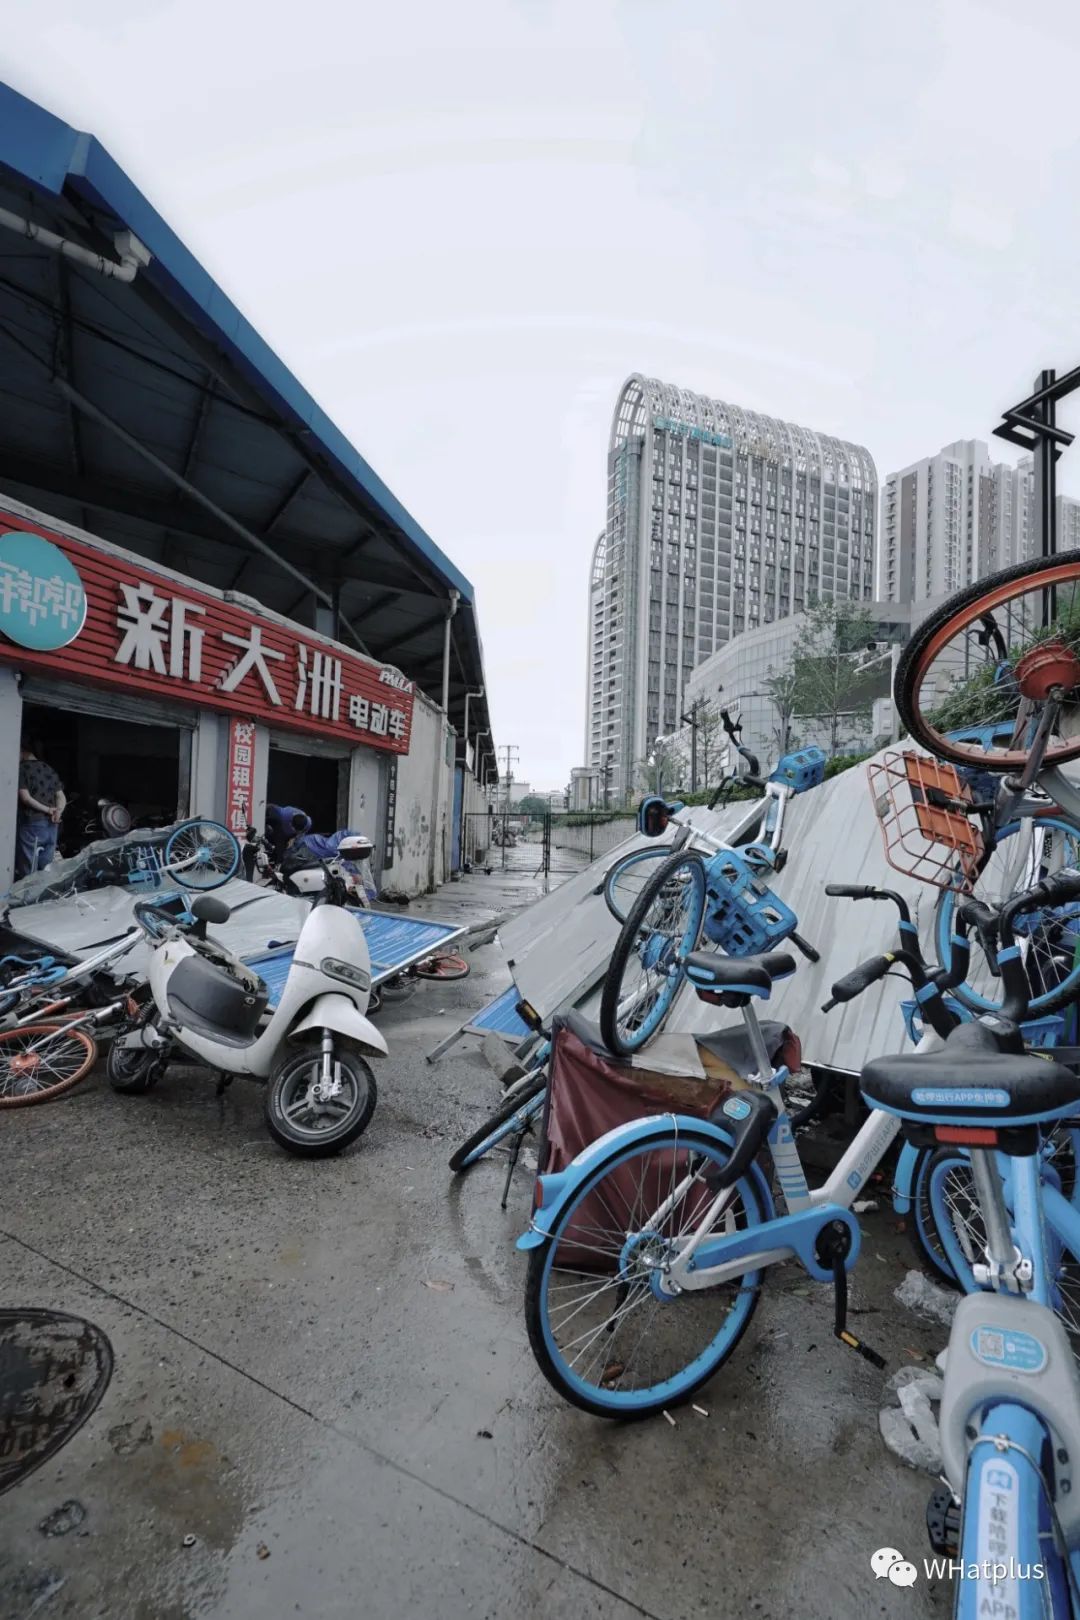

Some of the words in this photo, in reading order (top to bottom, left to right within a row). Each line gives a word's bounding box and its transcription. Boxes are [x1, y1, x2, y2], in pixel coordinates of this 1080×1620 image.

[114, 582, 344, 721] 新大洲
[349, 695, 406, 739] 电动车
